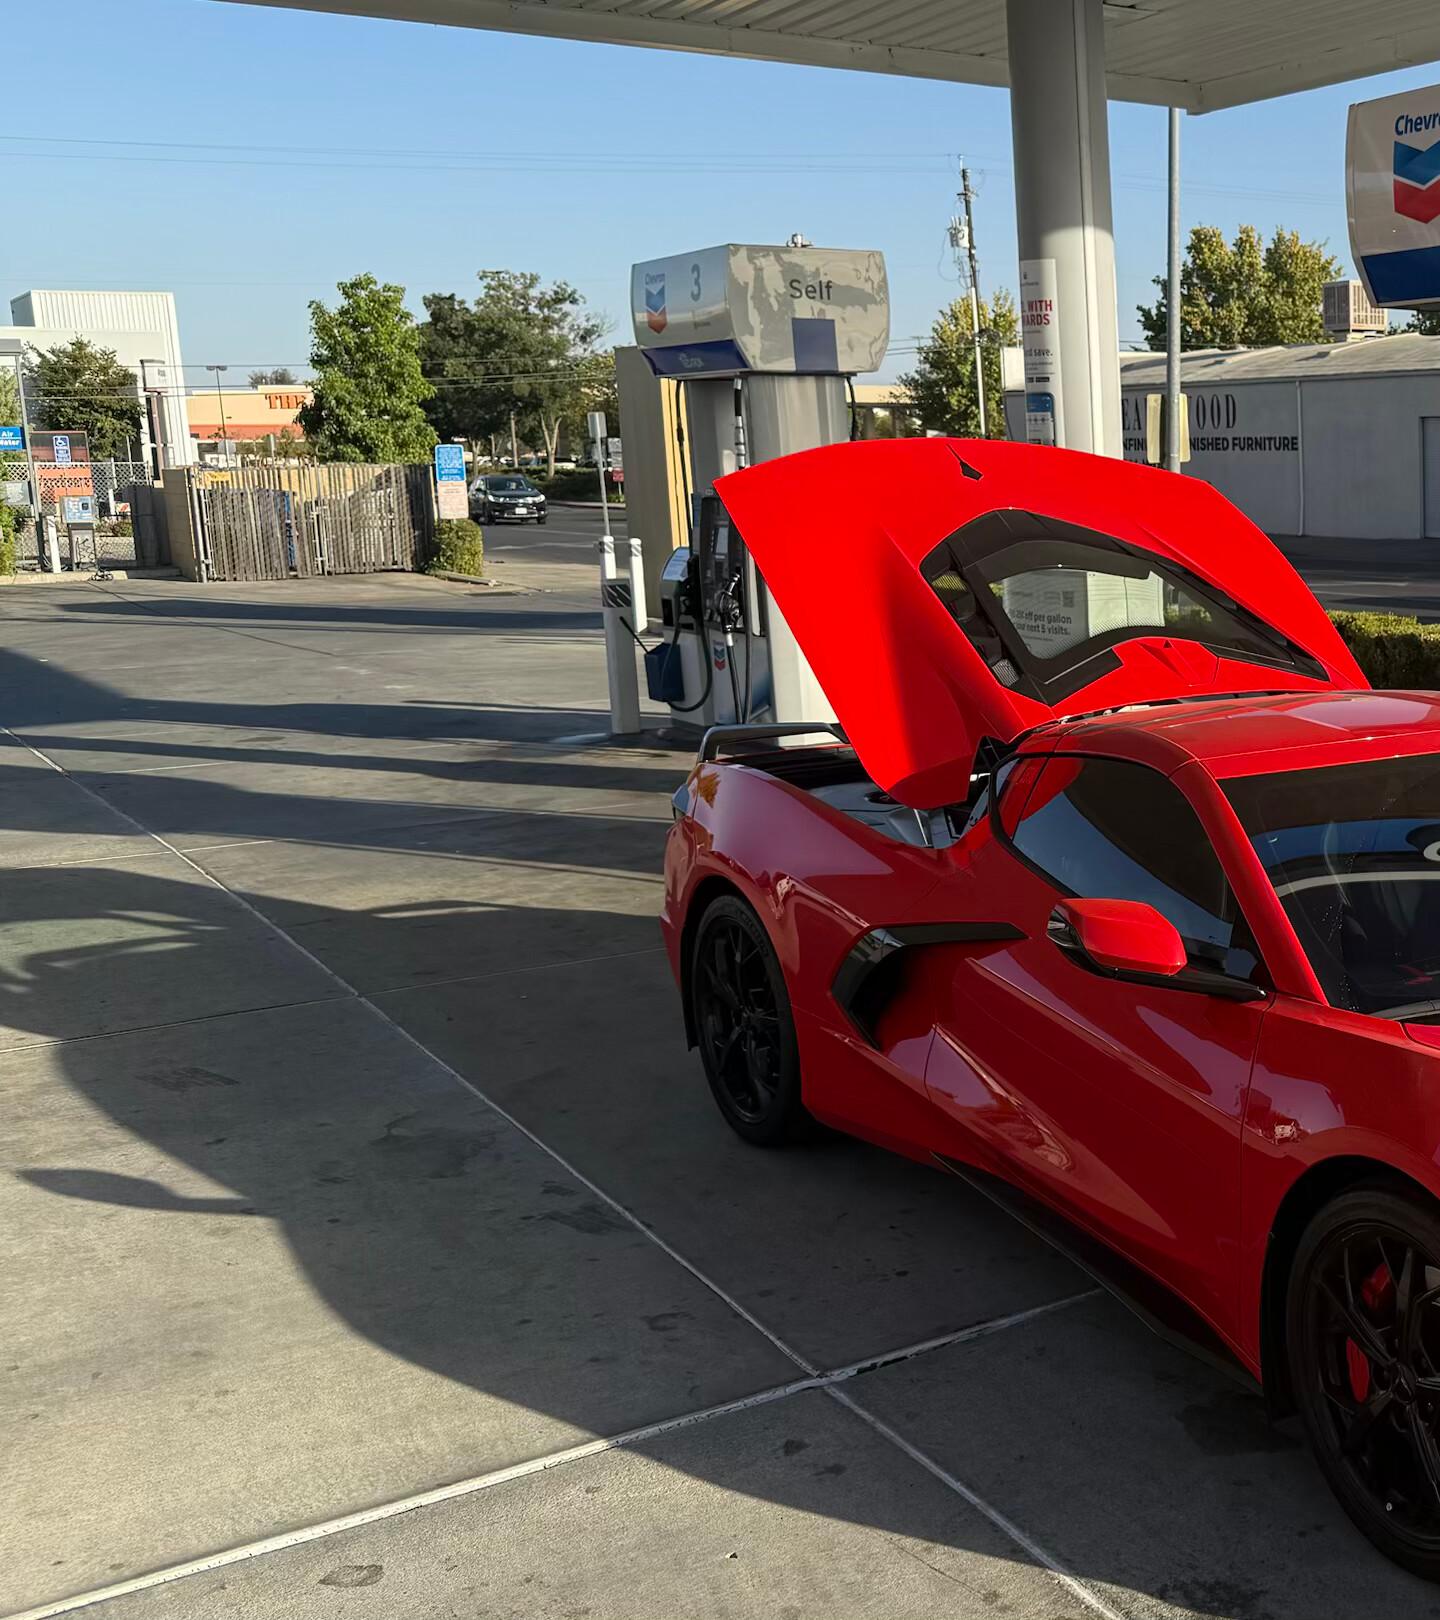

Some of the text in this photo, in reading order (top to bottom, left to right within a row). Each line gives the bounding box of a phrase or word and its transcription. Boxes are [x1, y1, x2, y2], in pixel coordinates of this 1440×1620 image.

[690, 264, 701, 302] 3
[789, 278, 833, 300] Self
[1027, 299, 1053, 313] WITH
[1232, 436, 1299, 451] FURNITURE
[1046, 613, 1072, 625] gallon
